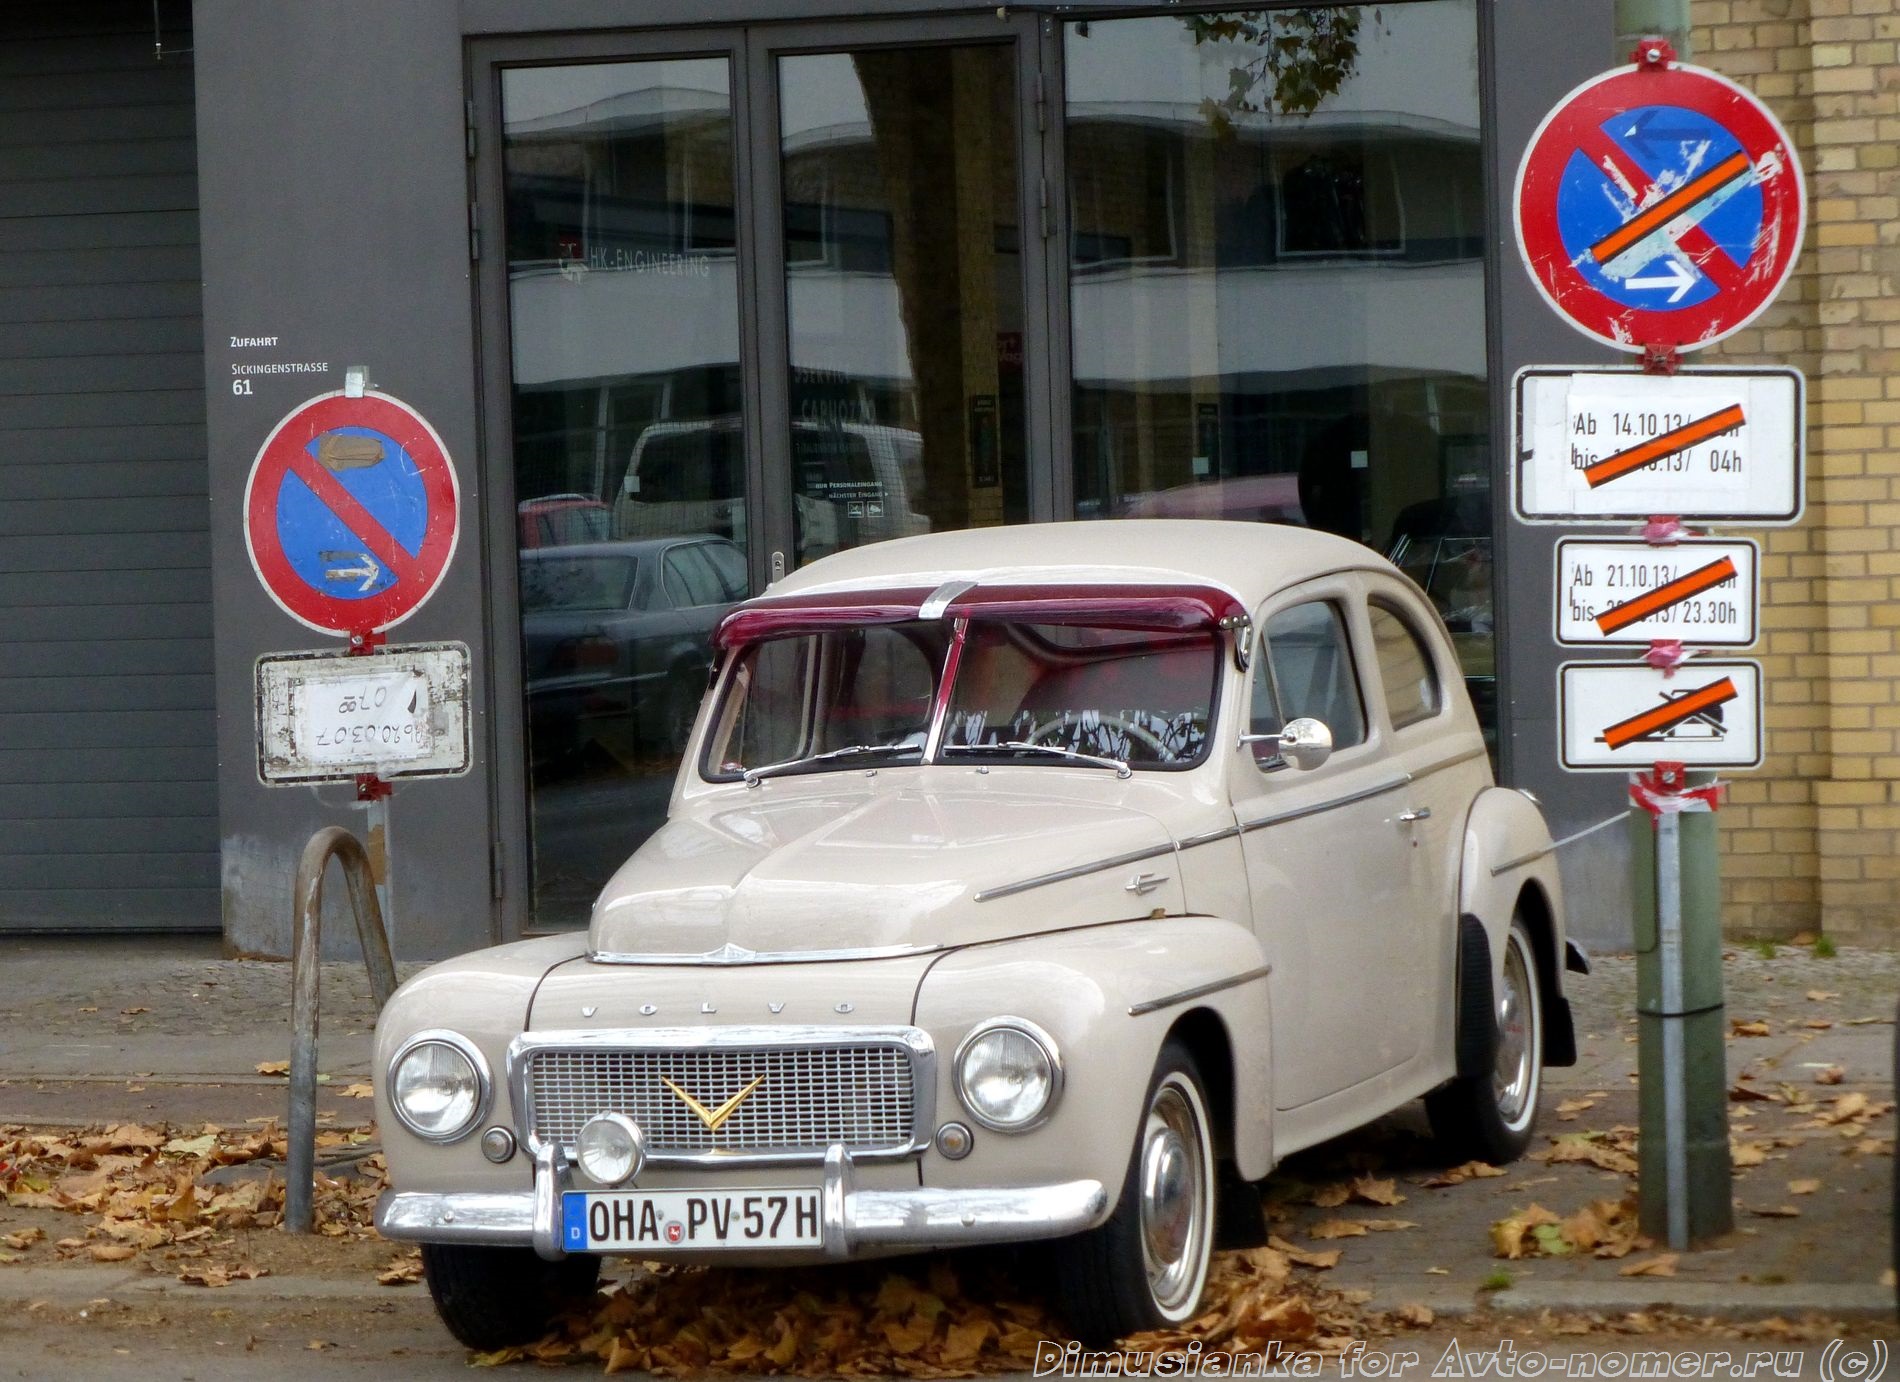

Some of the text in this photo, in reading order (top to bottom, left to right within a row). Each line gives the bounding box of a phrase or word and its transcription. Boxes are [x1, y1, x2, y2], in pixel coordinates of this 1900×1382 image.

[230, 336, 279, 348] ZUFAHRT
[231, 362, 329, 375] SICKINGENSTRASSE
[232, 379, 253, 396] 61
[1574, 412, 1597, 436] Ab
[1574, 447, 1598, 470] bis
[1710, 449, 1742, 472] 04h
[1573, 563, 1593, 586] Ab
[1572, 599, 1595, 621] bis
[1682, 601, 1737, 624] 23.30h
[581, 1001, 855, 1018] VOLVO
[570, 1226, 581, 1240] D
[589, 1199, 660, 1242] OHA
[687, 1198, 732, 1240] PV
